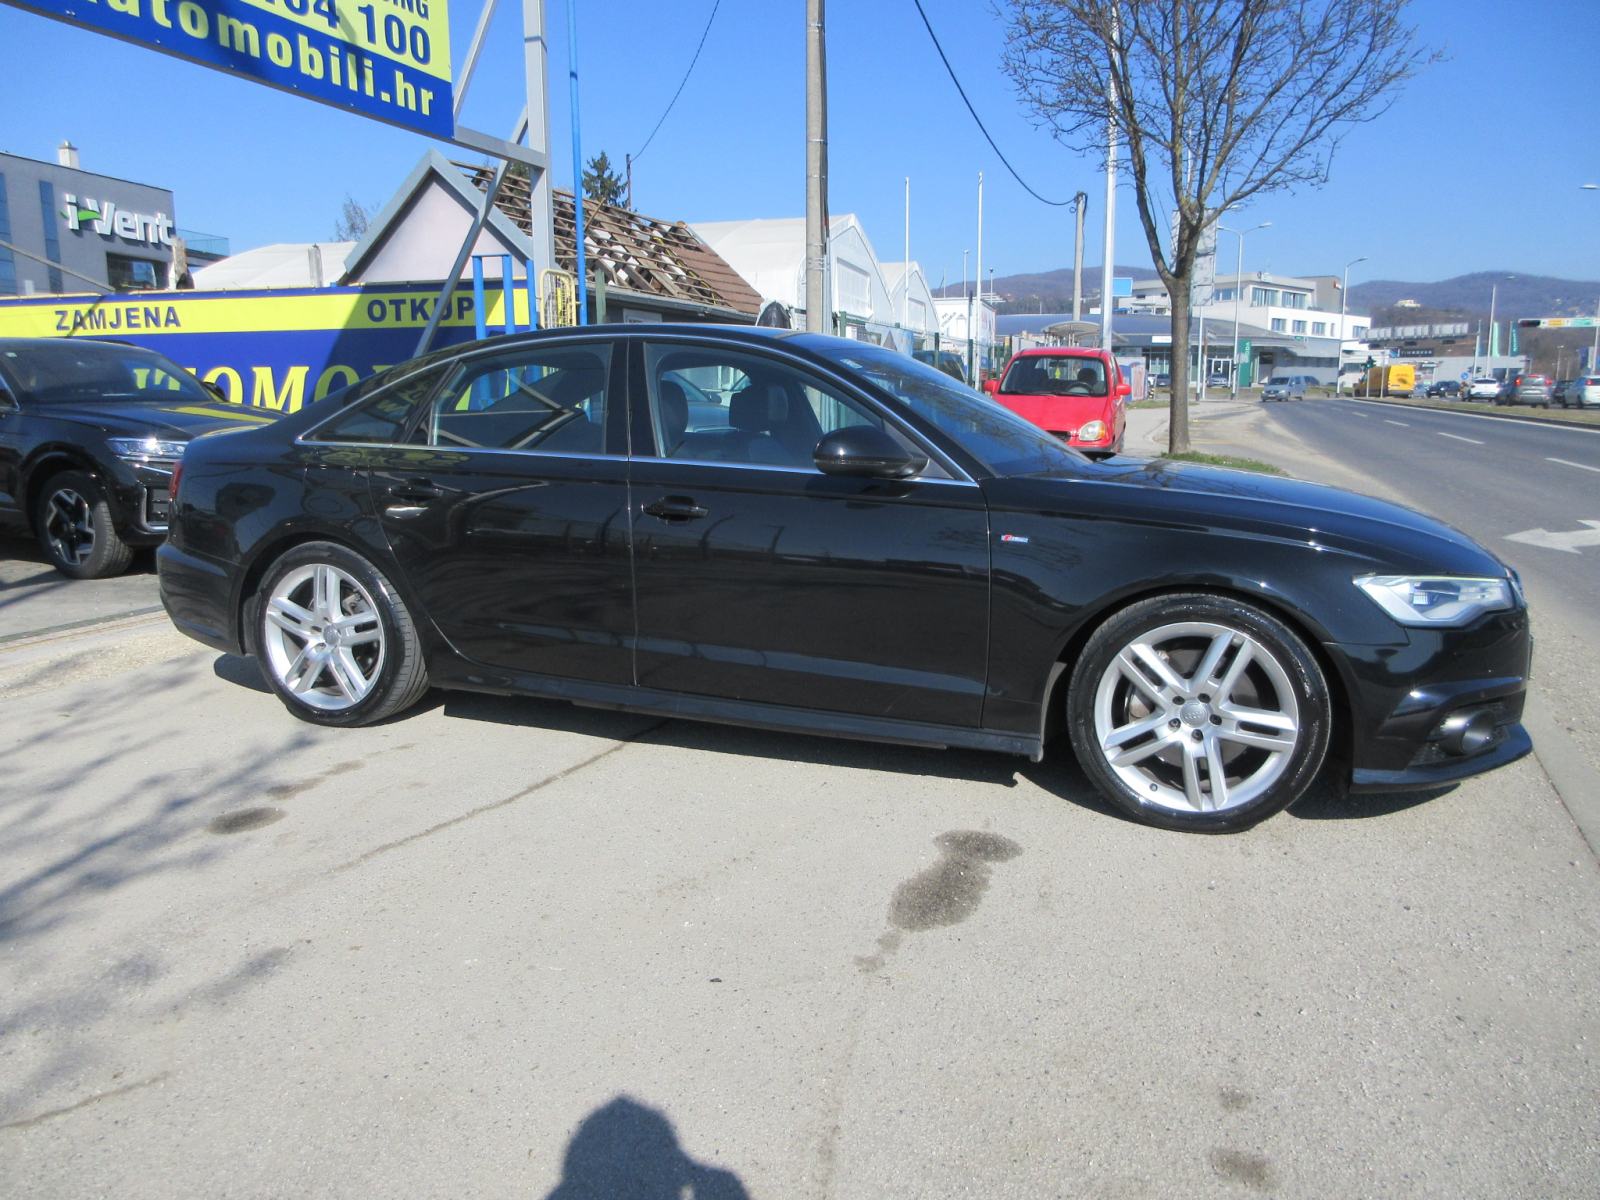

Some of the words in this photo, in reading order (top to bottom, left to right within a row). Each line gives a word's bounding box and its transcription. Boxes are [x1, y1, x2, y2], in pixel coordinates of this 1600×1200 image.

[358, 4, 431, 66] 100
[55, 306, 181, 331] ZAMJENA
[367, 296, 475, 322] OTKUP
